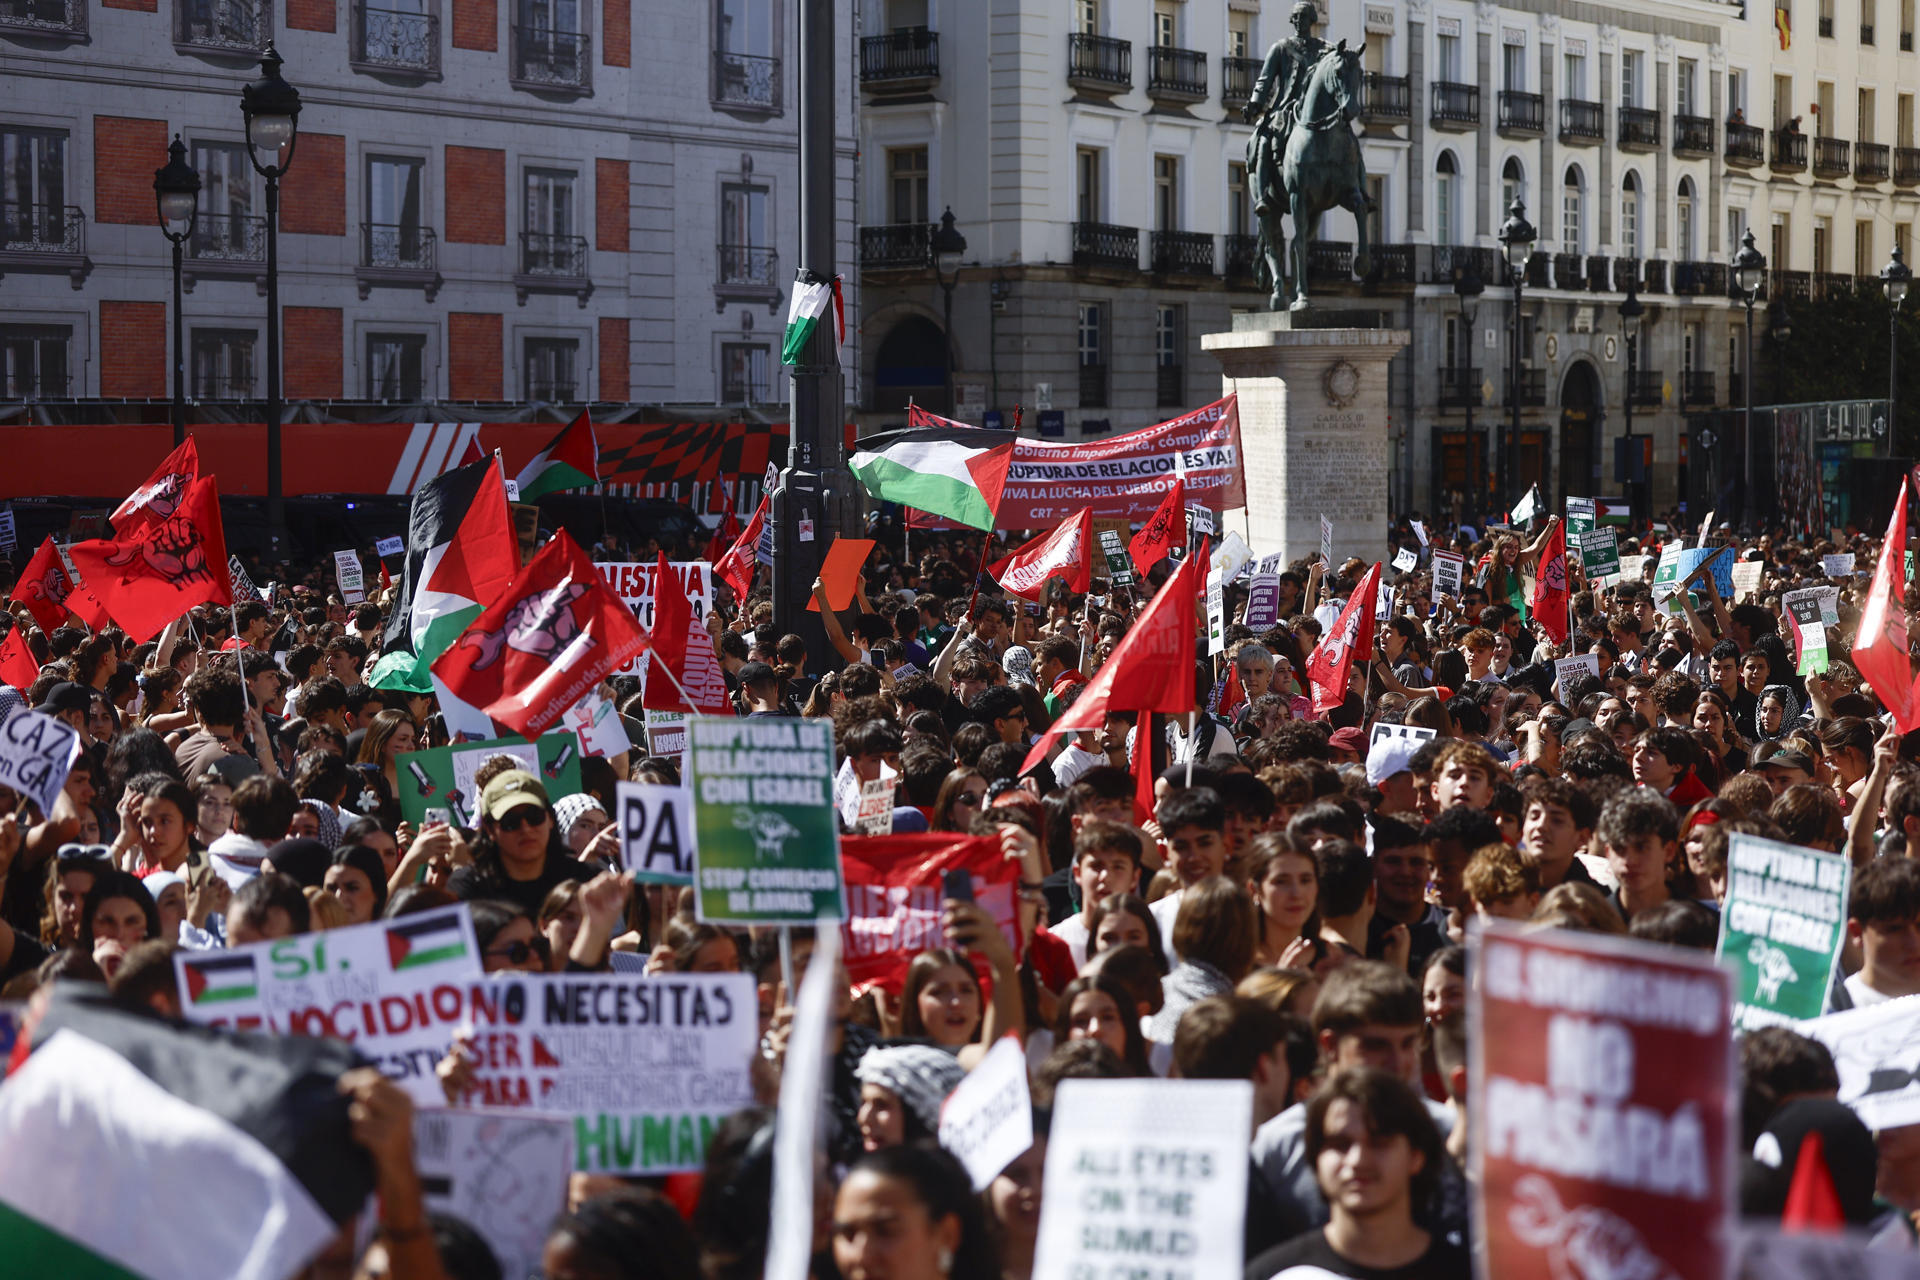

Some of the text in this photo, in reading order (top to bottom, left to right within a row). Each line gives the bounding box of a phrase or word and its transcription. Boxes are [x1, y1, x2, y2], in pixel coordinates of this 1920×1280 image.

[1367, 9, 1393, 24] RIESCO
[1158, 425, 1231, 449] cómplice!
[1006, 464, 1075, 479] RUPTURA
[1077, 465, 1098, 478] DE
[1206, 449, 1233, 467] YA!
[1001, 473, 1233, 500] VIVA LA LUCHA DEL PUEBLO PLESTINO
[1029, 507, 1054, 519] CRT
[1581, 530, 1606, 540] RUPTURA
[1582, 534, 1615, 546] RELACIONES
[1583, 543, 1596, 552] CON
[1438, 568, 1458, 580] ASESINA
[1440, 560, 1457, 571] ISRAEL
[1560, 661, 1588, 672] HUELGA
[527, 678, 585, 732] Sindicato
[693, 722, 828, 750] RUPTURA DE
[695, 749, 829, 779] RELACIONES
[701, 776, 750, 805] CON
[751, 777, 827, 806] ISRAEL
[625, 797, 693, 873] PA
[701, 867, 747, 890] STOP
[1732, 841, 1845, 894] RUPTURA DE
[1731, 870, 1841, 925] RELACIONES
[1729, 899, 1836, 955] CON ISRAEL
[469, 982, 734, 1026] NO NECESITAS
[467, 1031, 522, 1069] SER
[1548, 1013, 1635, 1101] NO
[462, 1076, 533, 1107] PARA
[1074, 1147, 1214, 1180] ALL EYES
[1083, 1185, 1195, 1218] ON THE
